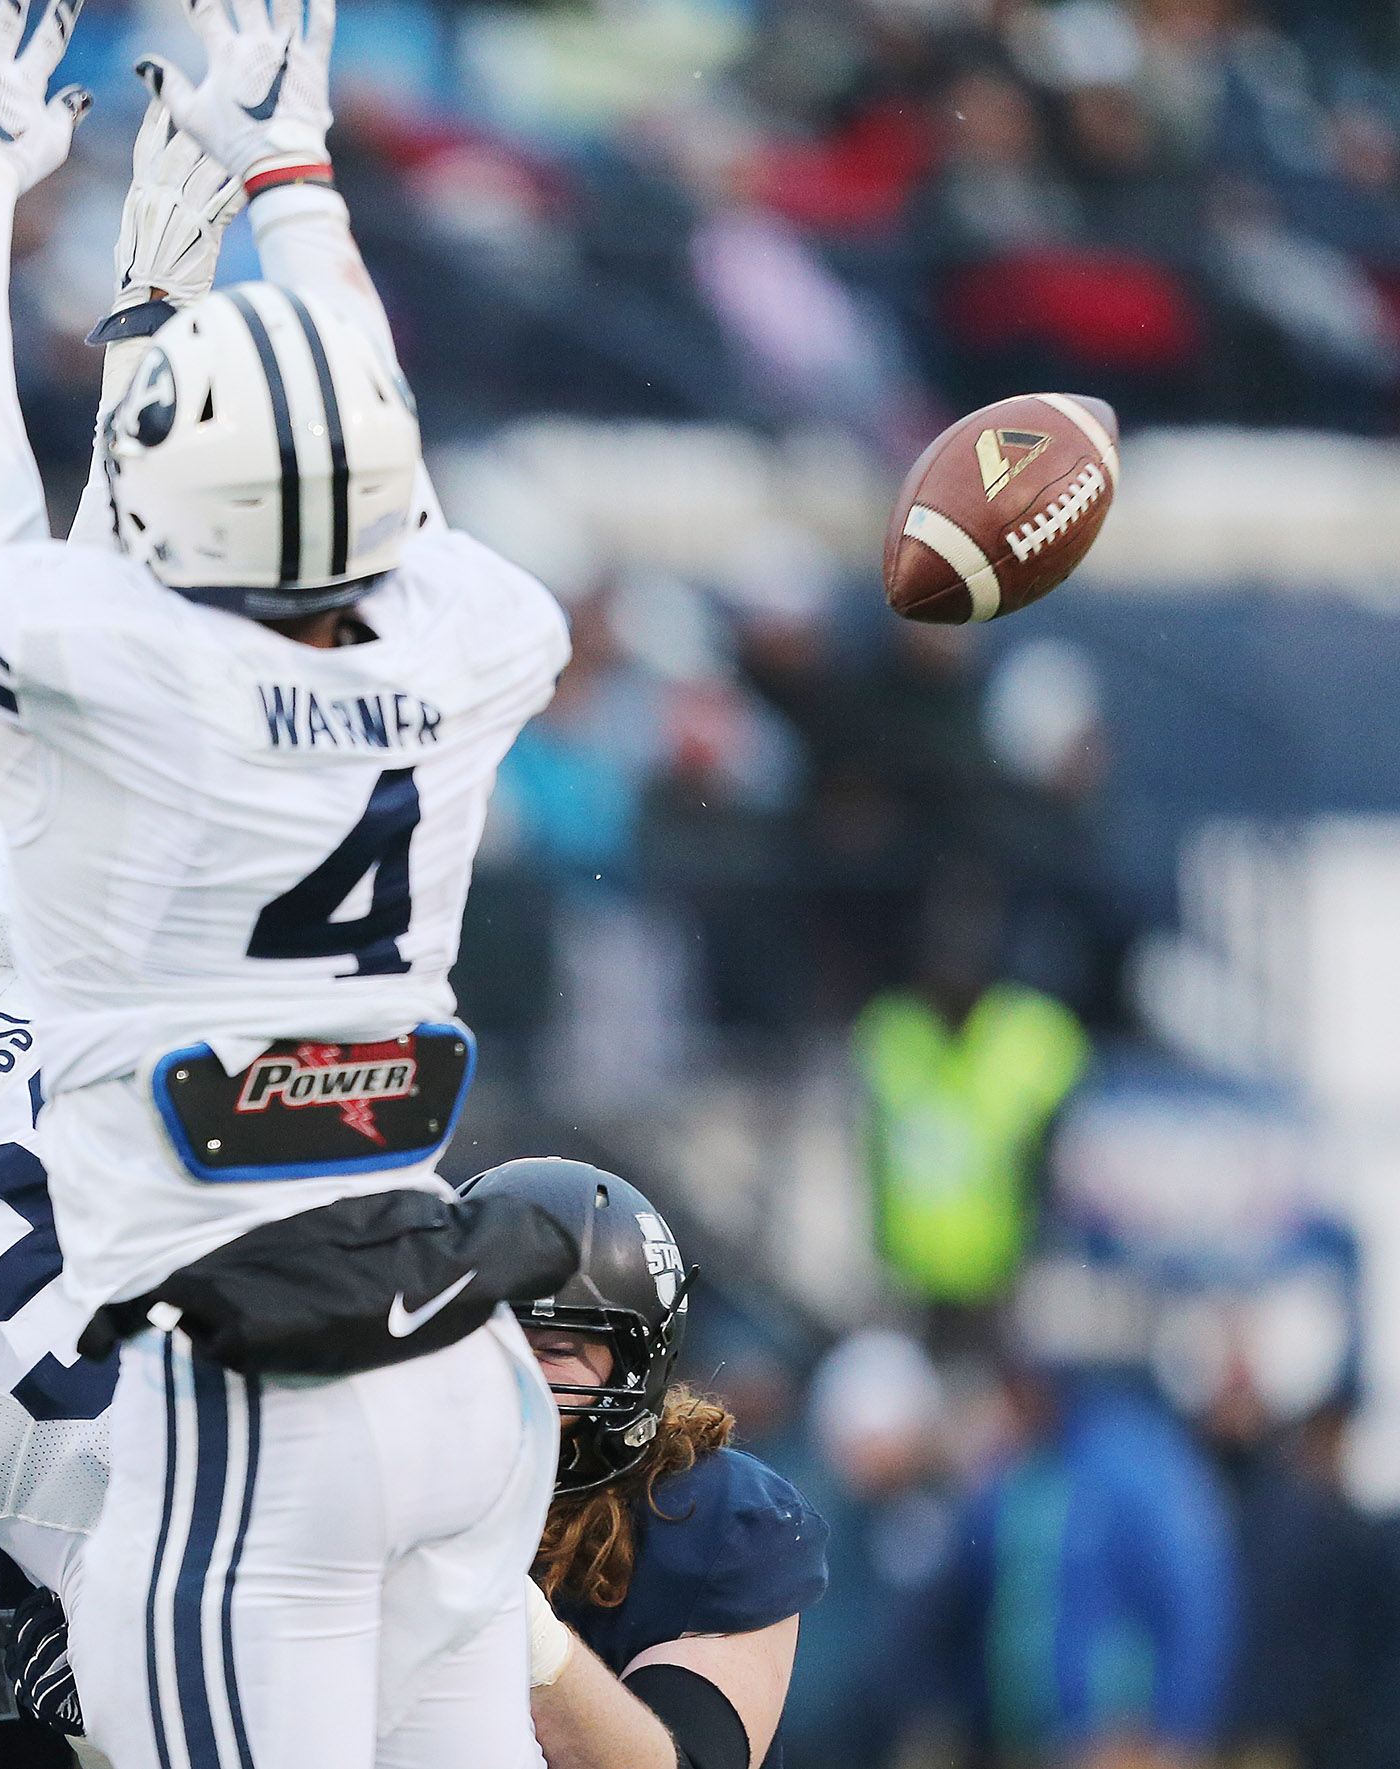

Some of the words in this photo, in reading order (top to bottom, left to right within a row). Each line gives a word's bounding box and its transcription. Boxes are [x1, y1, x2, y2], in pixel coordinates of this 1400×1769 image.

[257, 684, 442, 748] WARNER
[246, 766, 421, 978] 4
[241, 1060, 413, 1109] POWER
[645, 1243, 686, 1276] STA
